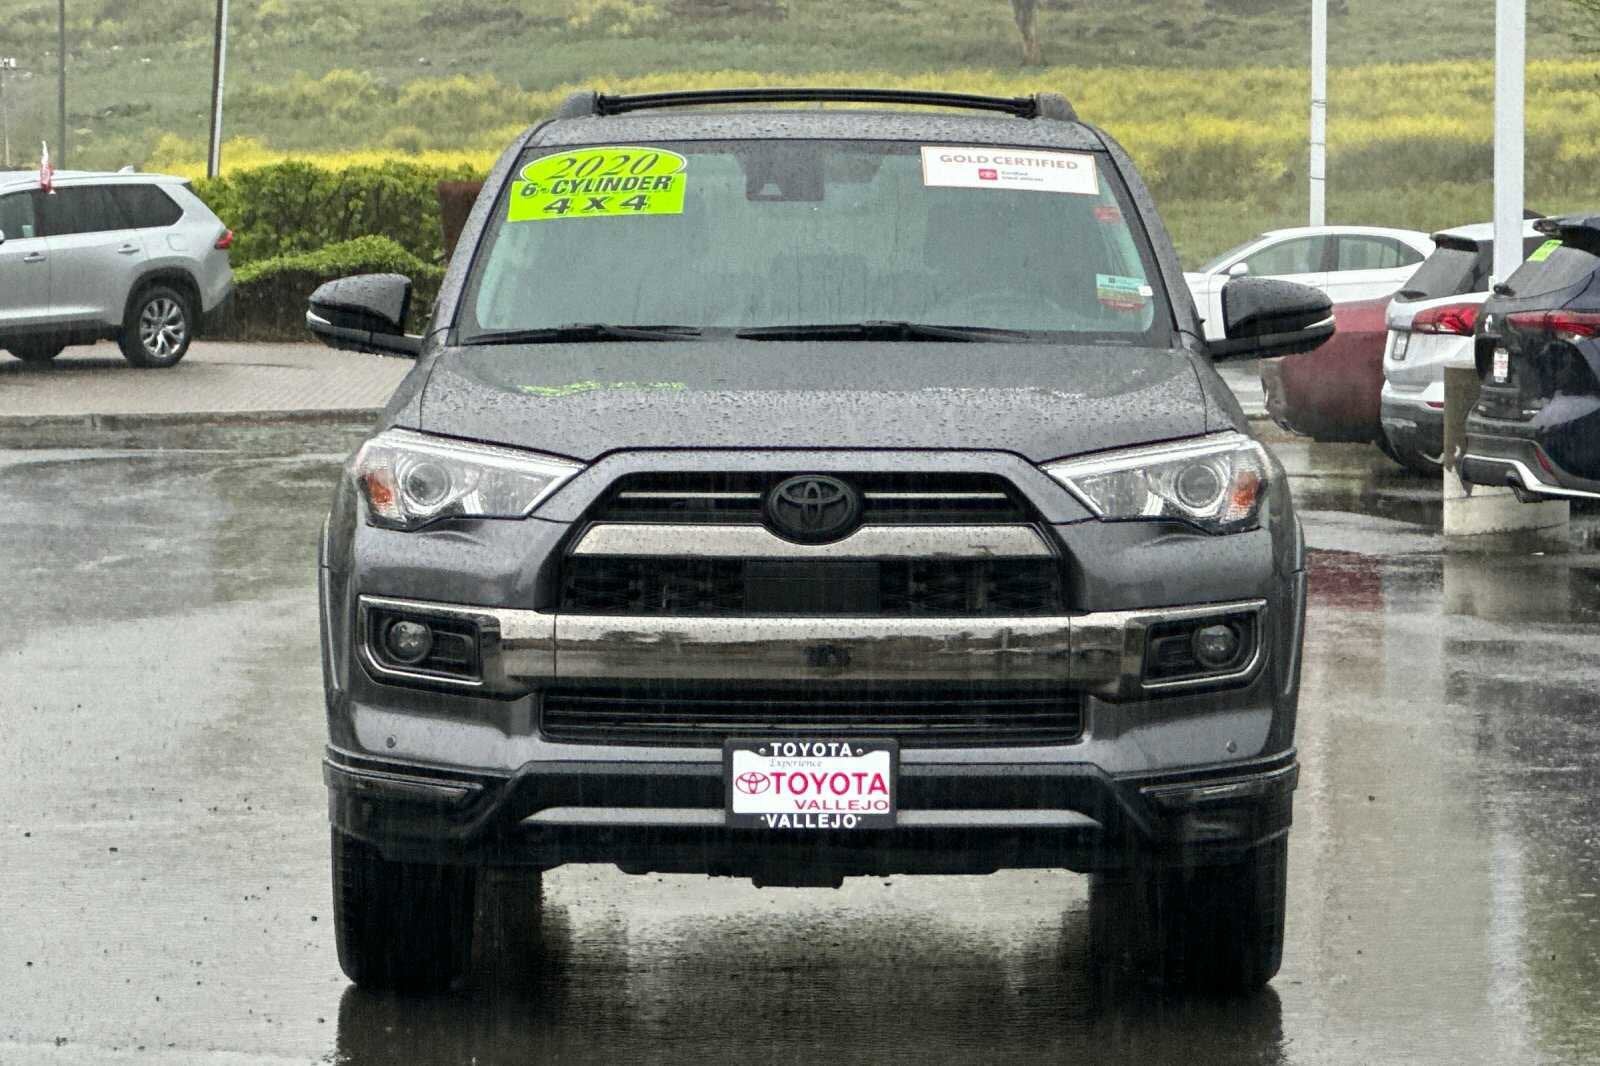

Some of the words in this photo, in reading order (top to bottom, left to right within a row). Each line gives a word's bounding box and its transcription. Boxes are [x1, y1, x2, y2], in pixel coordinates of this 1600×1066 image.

[546, 154, 660, 179] 2020
[940, 154, 989, 164] GOLD
[993, 155, 1078, 170] CERTIFIED
[770, 742, 853, 757] TOYOTA
[770, 772, 889, 796] TOYOTA
[793, 799, 889, 811] VALLEJO
[765, 813, 857, 829] VALLEJO
